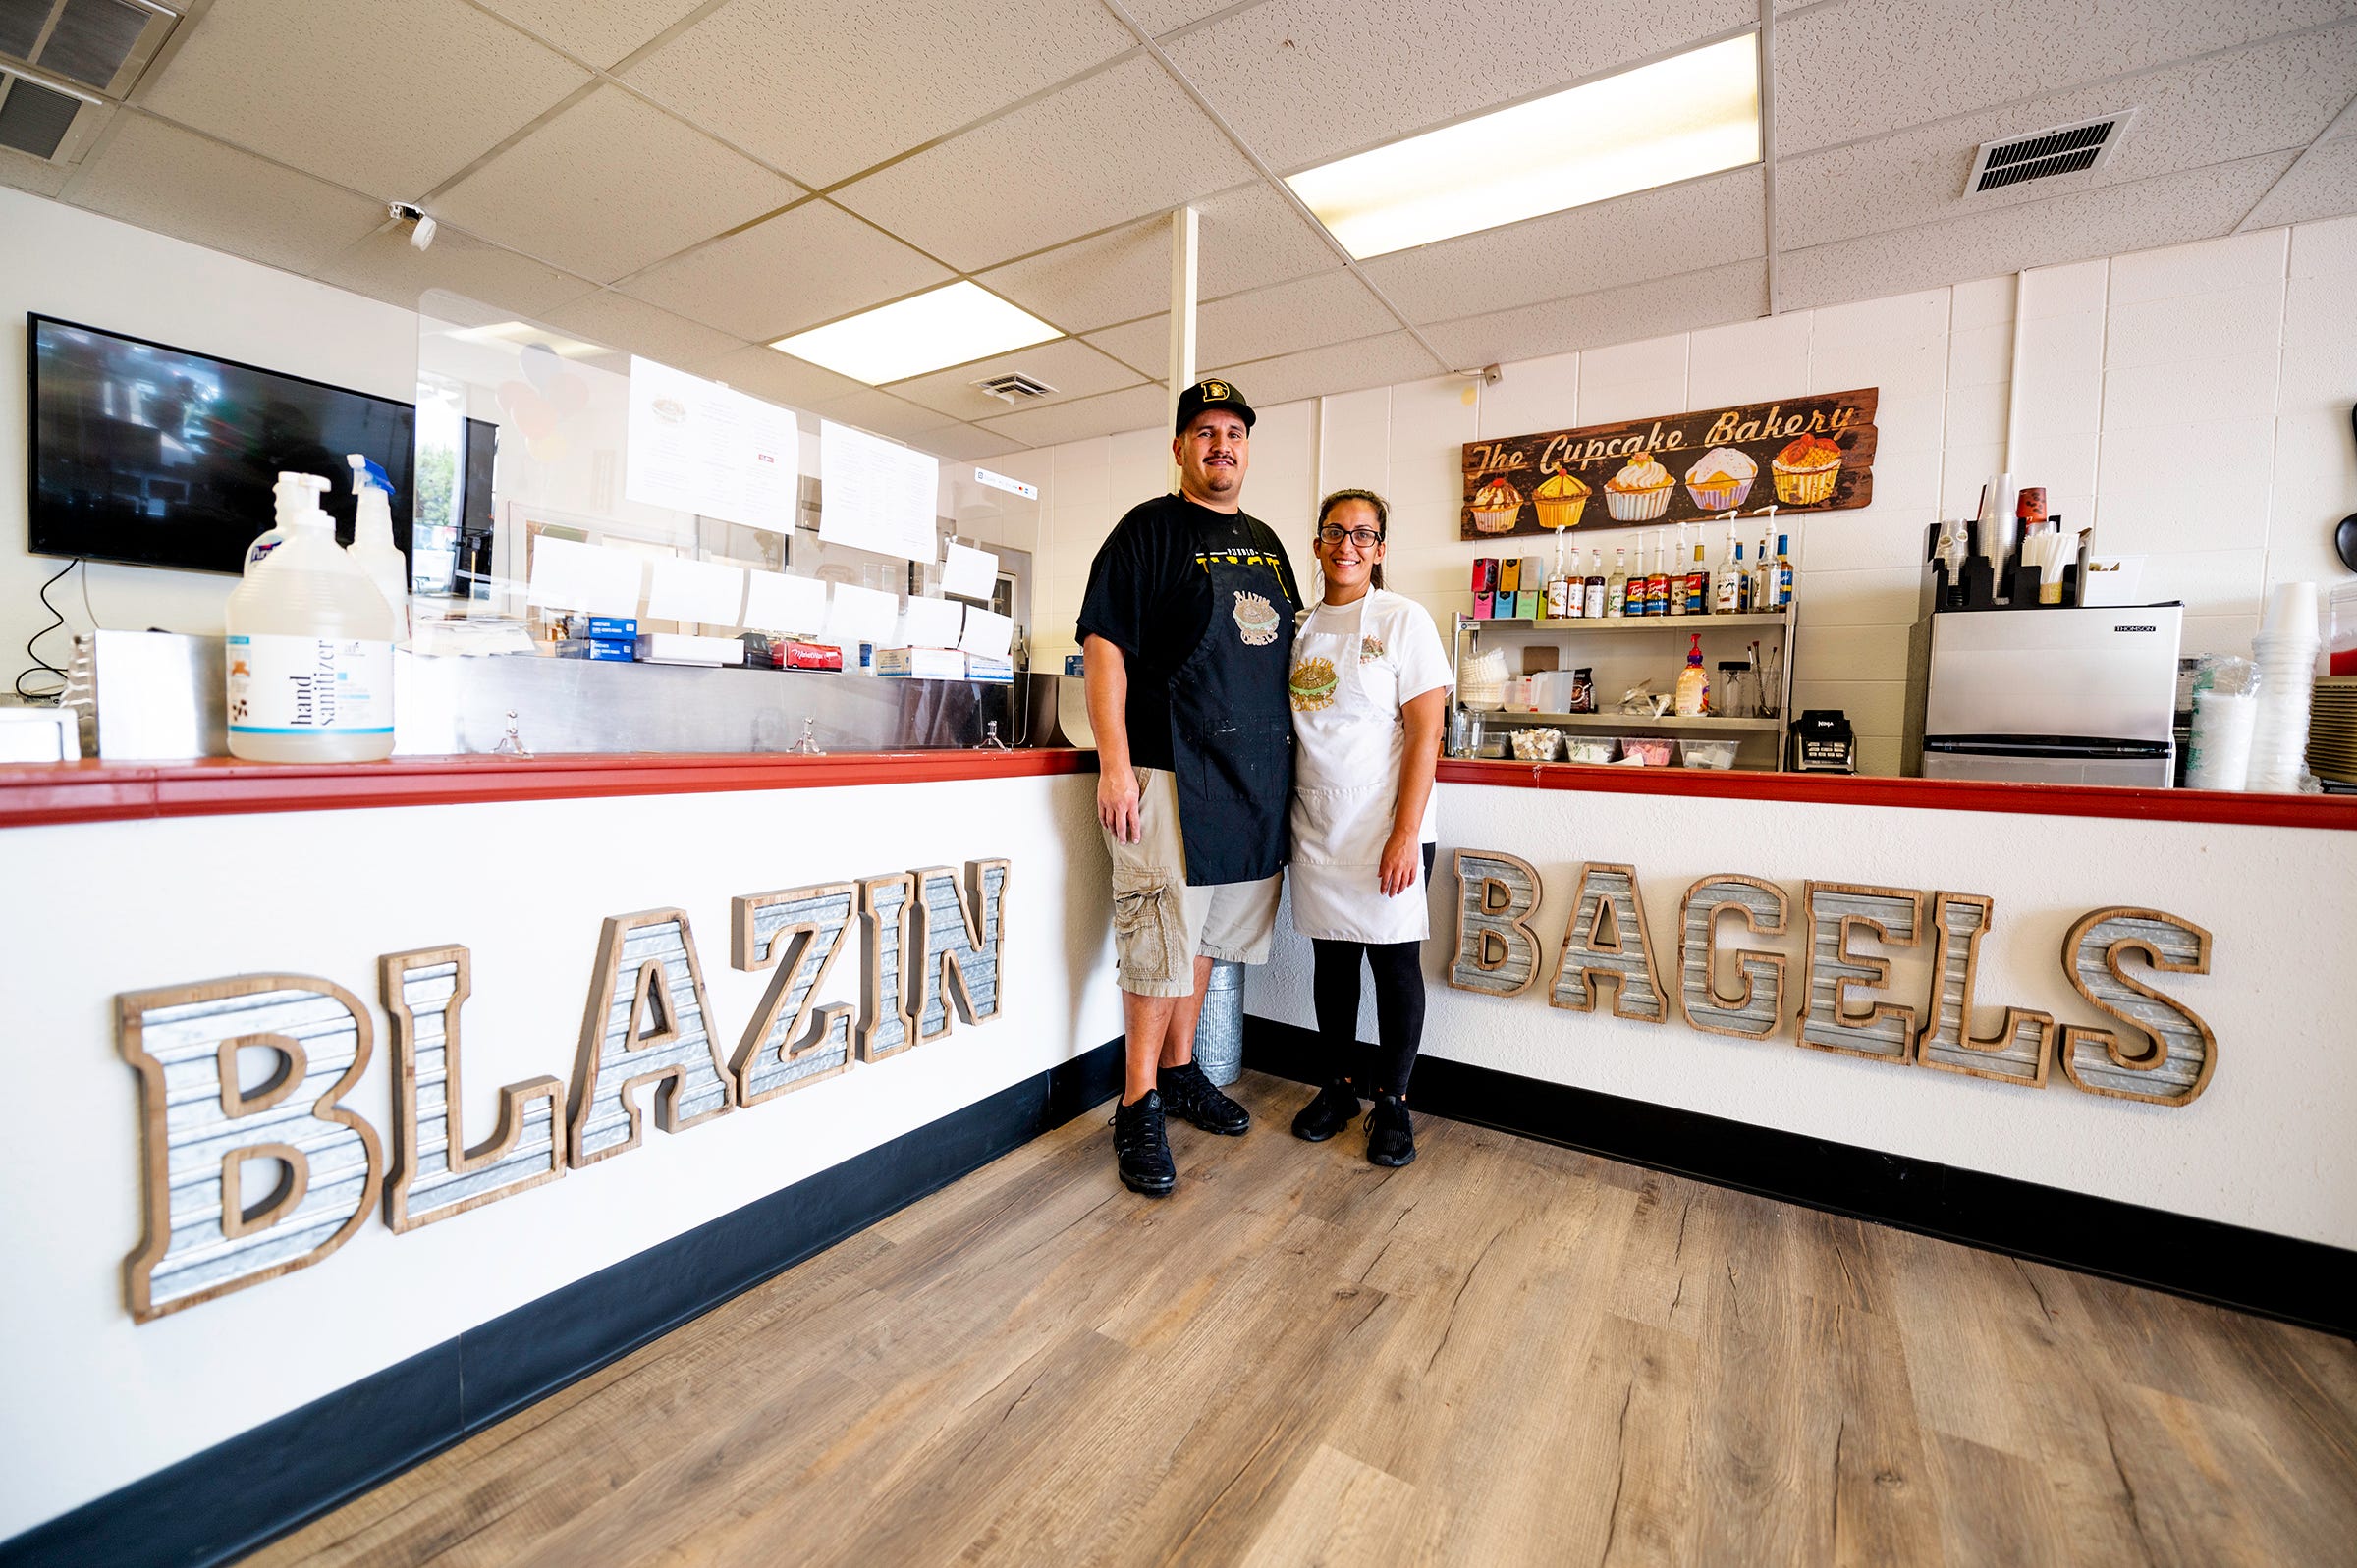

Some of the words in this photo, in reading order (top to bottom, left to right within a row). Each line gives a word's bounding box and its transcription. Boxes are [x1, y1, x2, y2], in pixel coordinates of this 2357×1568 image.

[1467, 443, 1528, 480] The
[1539, 422, 1683, 474] Cupcake
[1704, 406, 1855, 448] Bakery
[290, 676, 312, 725] hand
[314, 640, 335, 726] sanitizer
[1295, 656, 1334, 676] BLAZIN
[1449, 847, 2218, 1108] BAGELS
[115, 858, 1012, 1325] BLAZIN
